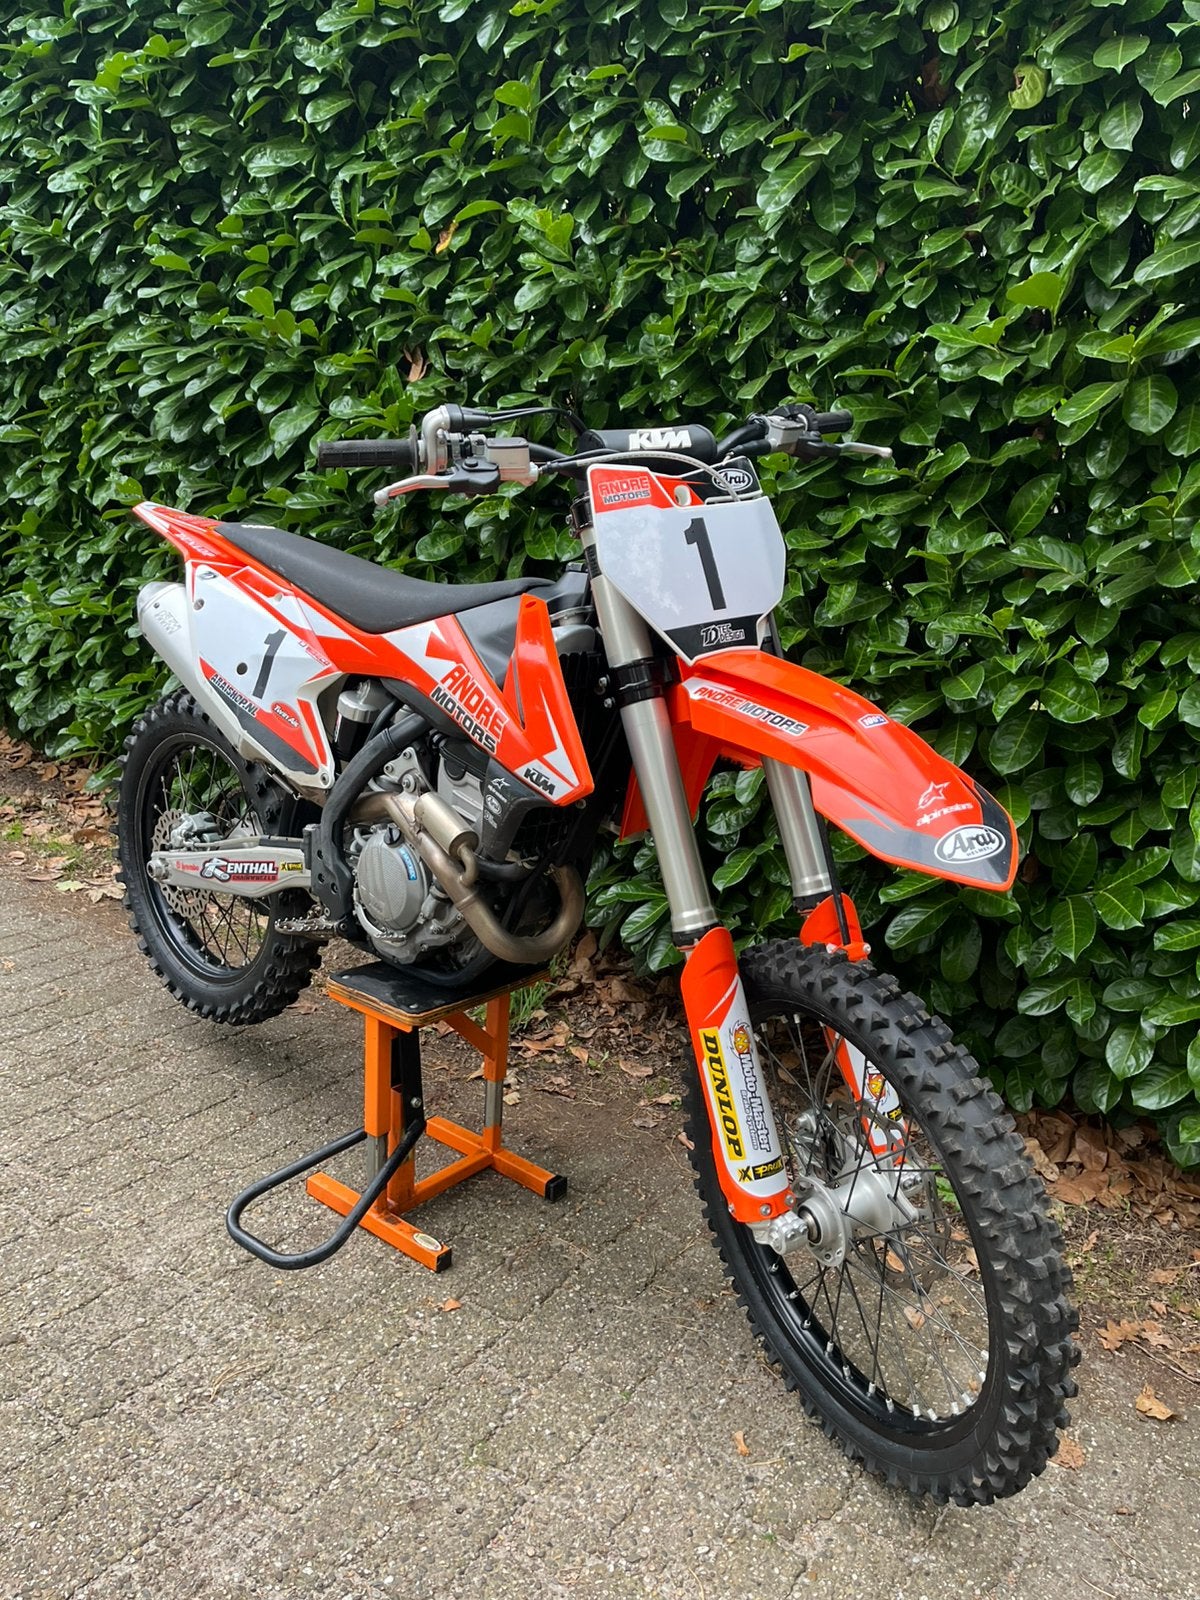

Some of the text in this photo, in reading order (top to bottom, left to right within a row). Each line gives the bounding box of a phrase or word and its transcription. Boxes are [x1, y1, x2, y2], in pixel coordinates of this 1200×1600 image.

[629, 428, 692, 450] KTM
[599, 476, 650, 496] ANDRE
[603, 489, 651, 505] MOTORS
[684, 517, 727, 611] 1
[253, 629, 288, 699] 1
[210, 673, 259, 718] ARAISHOP.NL
[439, 663, 510, 744] ANDRE
[694, 686, 809, 736] ANDRE MOTORS
[430, 685, 498, 754] MOTORS
[523, 768, 556, 796] KTM
[945, 828, 996, 859] Arai
[703, 1032, 743, 1158] DUNLOP
